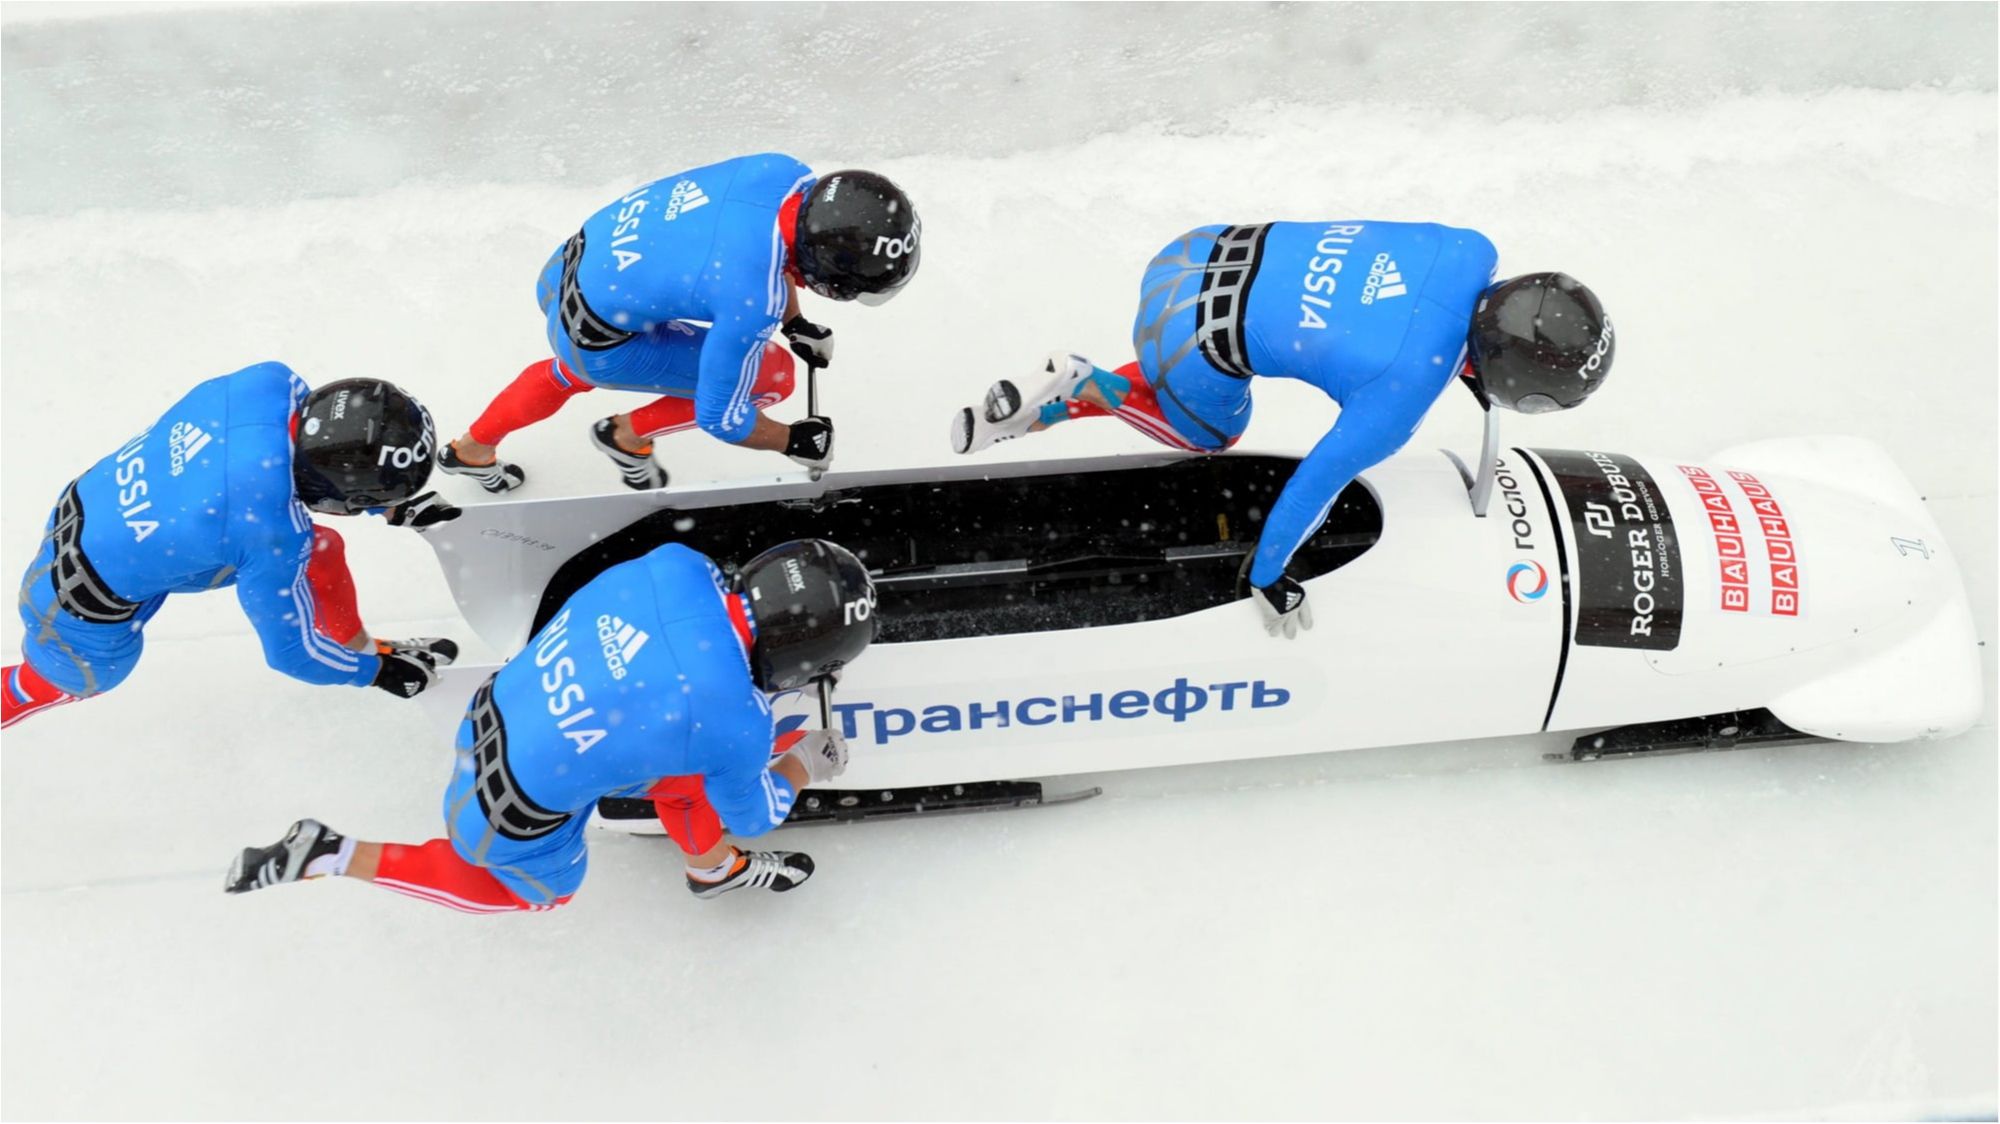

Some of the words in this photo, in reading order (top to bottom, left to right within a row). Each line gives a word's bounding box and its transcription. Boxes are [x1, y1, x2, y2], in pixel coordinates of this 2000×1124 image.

[611, 187, 650, 272] USSIA
[664, 179, 690, 221] adidas
[1299, 225, 1365, 329] RUSSIA
[1361, 252, 1390, 305] adidas
[333, 390, 350, 420] uvex
[169, 421, 184, 477] adidas
[116, 432, 159, 543] USSIA
[1586, 451, 1645, 522] DUBUIS
[1652, 522, 1670, 578] HORLOGER
[1679, 466, 1746, 609] BAUHAUS
[1728, 472, 1797, 613] BAUHAUS
[785, 558, 806, 592] uvex
[1629, 527, 1656, 637] ROGER
[535, 607, 608, 755] RUSSIA
[596, 613, 628, 680] adidas
[831, 677, 1292, 745] Транснефть
